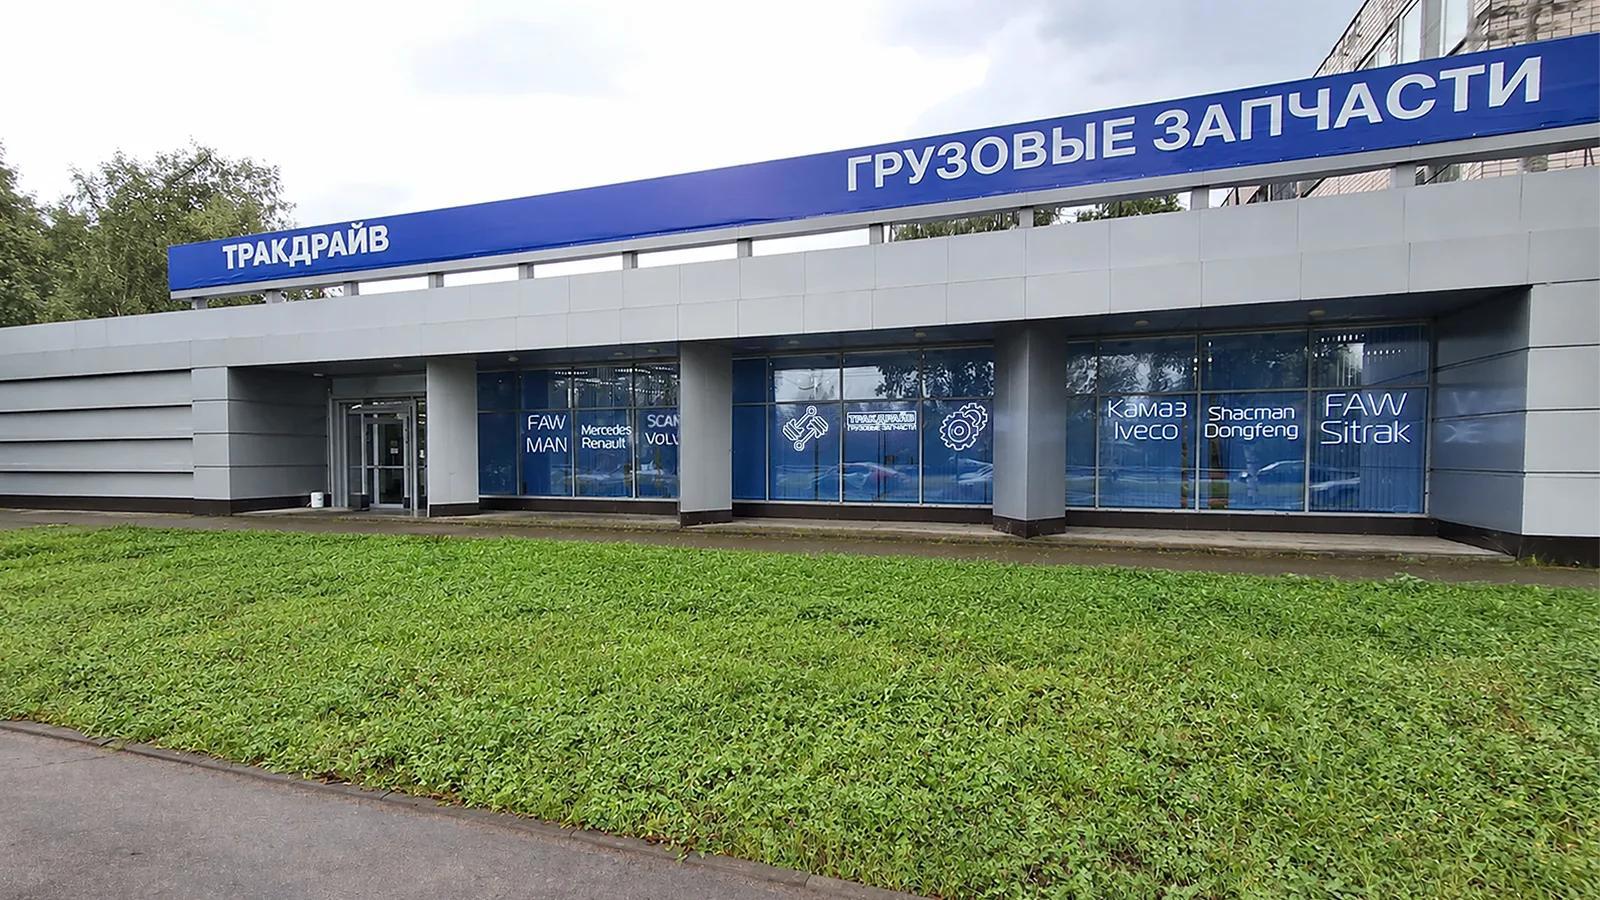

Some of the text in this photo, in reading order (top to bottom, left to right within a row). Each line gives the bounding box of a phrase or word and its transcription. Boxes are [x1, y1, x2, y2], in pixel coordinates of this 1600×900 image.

[847, 56, 1542, 193] ГРУЗОВЫЕ ЗАПЧАСТИ
[222, 221, 390, 270] ТРАКДРАЙВ
[1108, 399, 1187, 418] Камаз
[1325, 392, 1408, 417] FAW
[528, 414, 567, 430] FAW
[1208, 406, 1295, 422] Shacman
[581, 424, 632, 436] Mercedes
[1114, 422, 1179, 440] Iveco
[1204, 422, 1299, 441] Dongfeng
[1320, 420, 1411, 445] Sitrak
[526, 437, 567, 453] MAN
[581, 436, 627, 449] Renault
